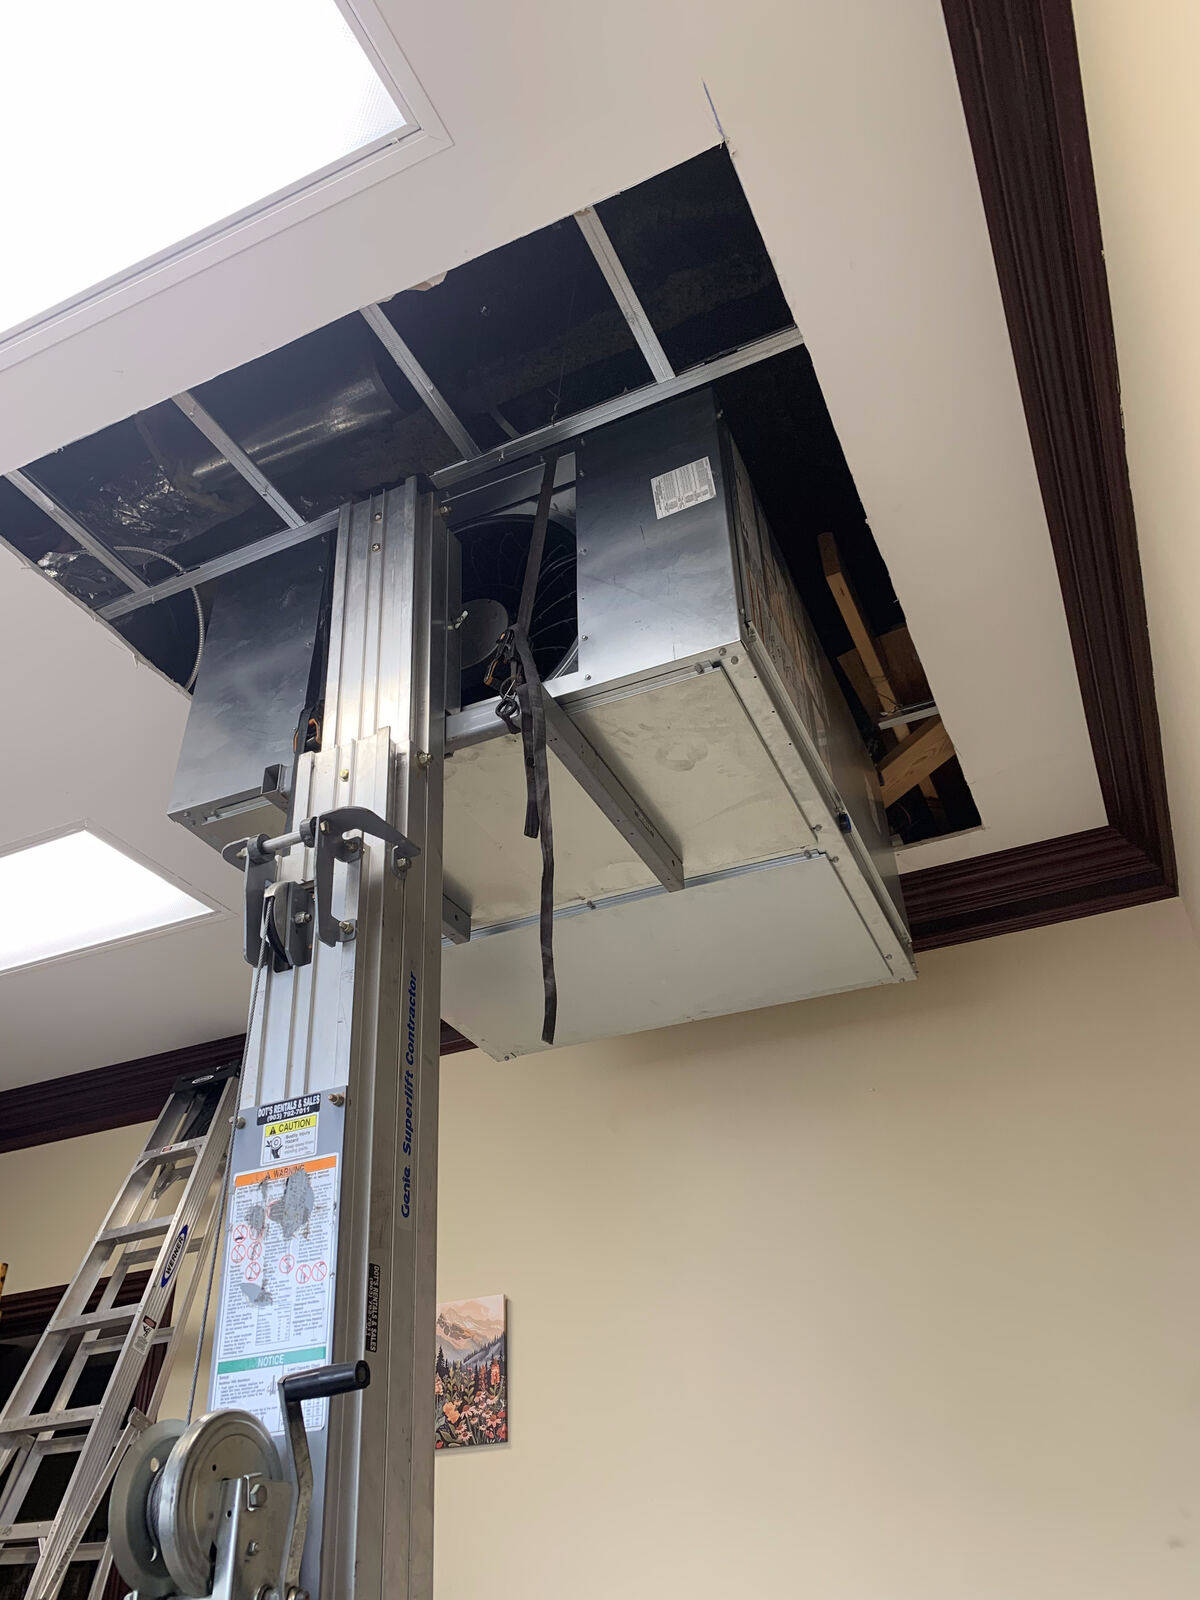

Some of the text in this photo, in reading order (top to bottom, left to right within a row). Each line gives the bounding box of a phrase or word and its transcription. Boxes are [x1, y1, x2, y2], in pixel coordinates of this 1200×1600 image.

[401, 970, 416, 1218] Genie Superlift Contractor
[258, 1095, 320, 1117] DOT'S RENTALS & SALES
[266, 1113, 282, 1123] (903)
[279, 1118, 311, 1132] CAUTION
[273, 1163, 305, 1178] WARNNG
[165, 1235, 184, 1275] WERNER
[371, 1288, 379, 1320] RENTALS
[369, 1327, 377, 1352] SALES
[257, 1354, 285, 1367] NOTICE
